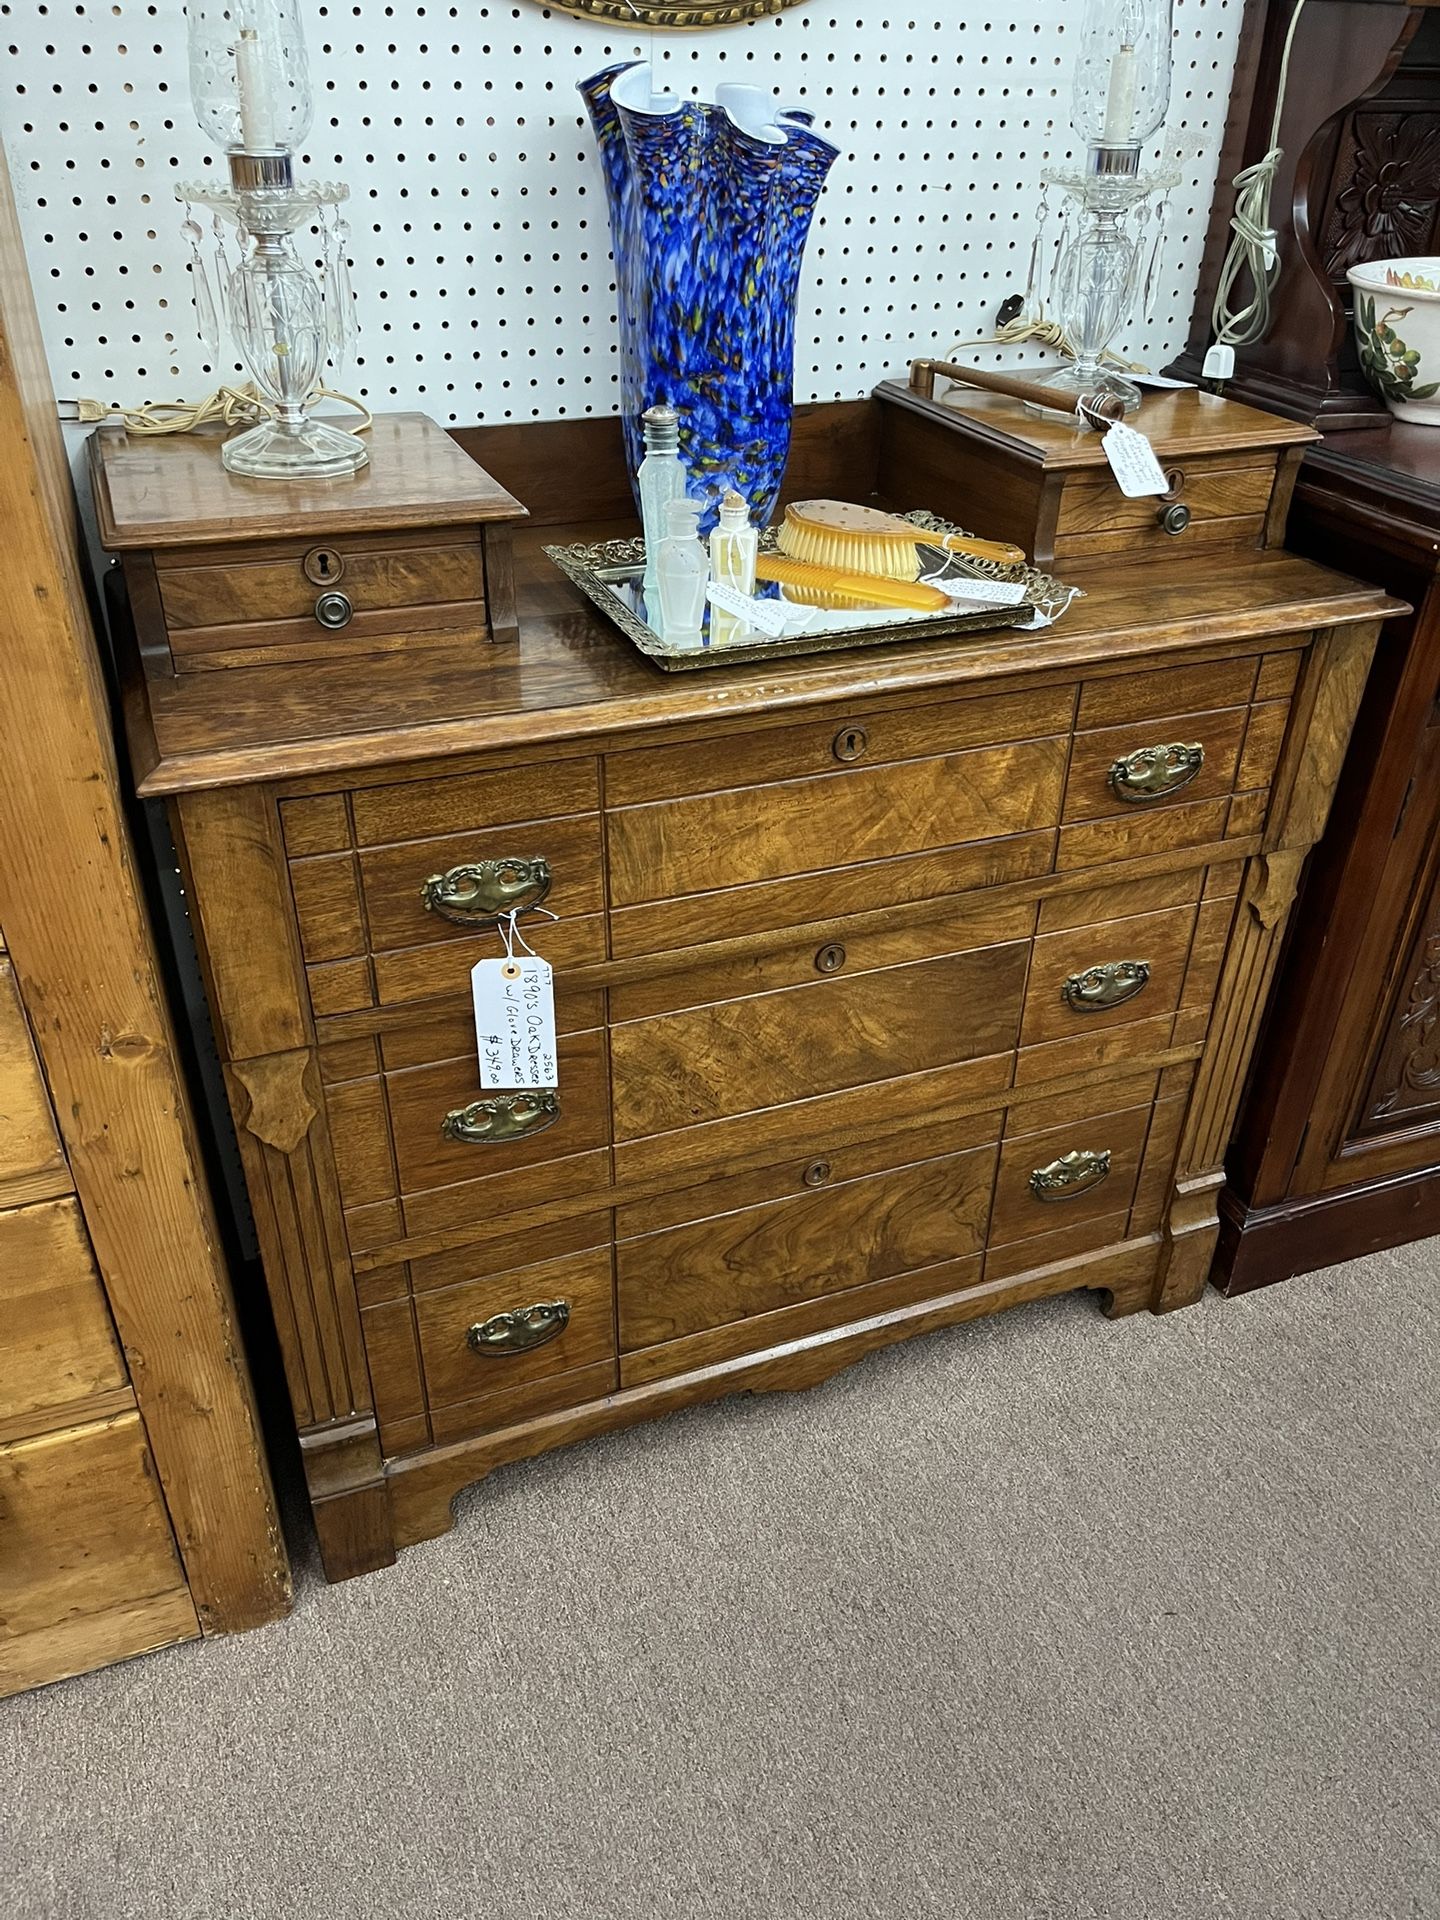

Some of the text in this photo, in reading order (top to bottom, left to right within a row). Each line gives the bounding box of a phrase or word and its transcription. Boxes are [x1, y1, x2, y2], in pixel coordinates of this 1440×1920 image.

[522, 969, 541, 1010] 1890's
[505, 1005, 519, 1035] Glove
[543, 1053, 554, 1081] 2563
